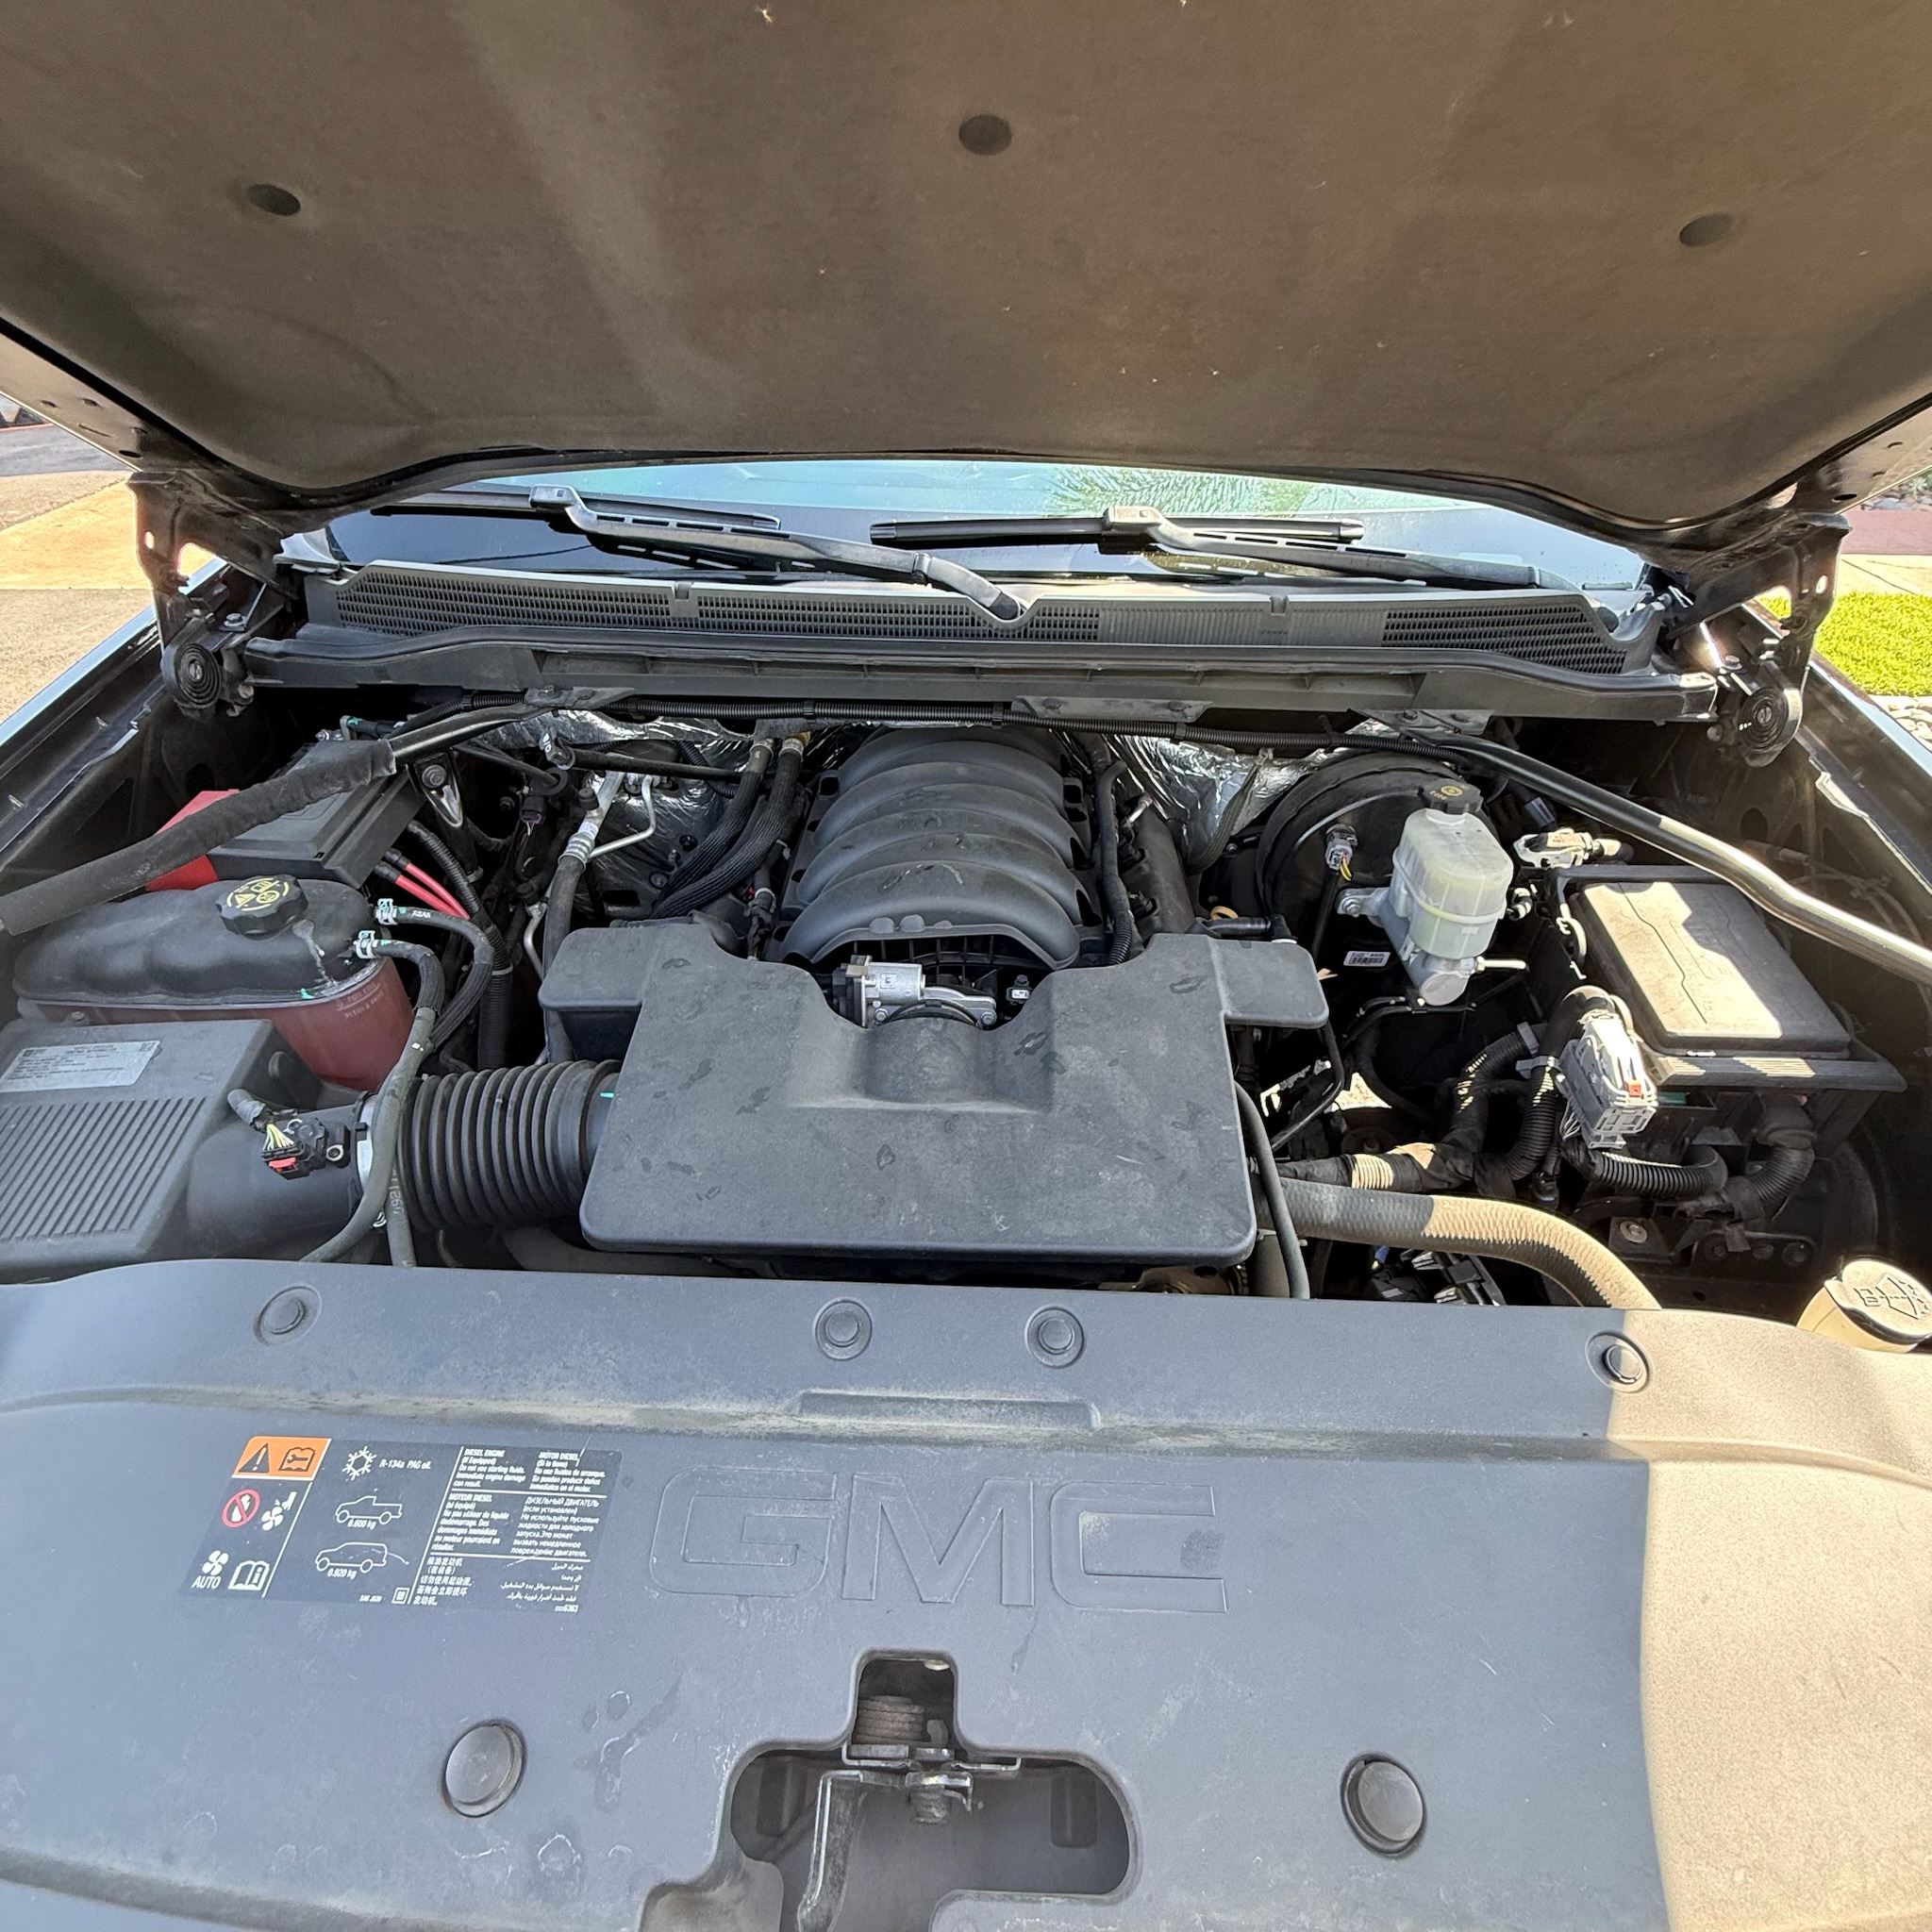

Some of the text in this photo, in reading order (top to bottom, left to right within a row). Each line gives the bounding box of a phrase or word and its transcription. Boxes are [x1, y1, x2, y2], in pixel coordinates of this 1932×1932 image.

[484, 1449, 506, 1457] ENGINE
[379, 1458, 405, 1468] R-134a
[407, 1460, 422, 1469] PAG
[564, 1498, 599, 1507] ДВИГАТЕЛЬ
[367, 1520, 376, 1530] kg
[648, 1465, 1228, 1612] GMC
[327, 1568, 357, 1580] 0.920 kg
[192, 1575, 221, 1590] AUTO
